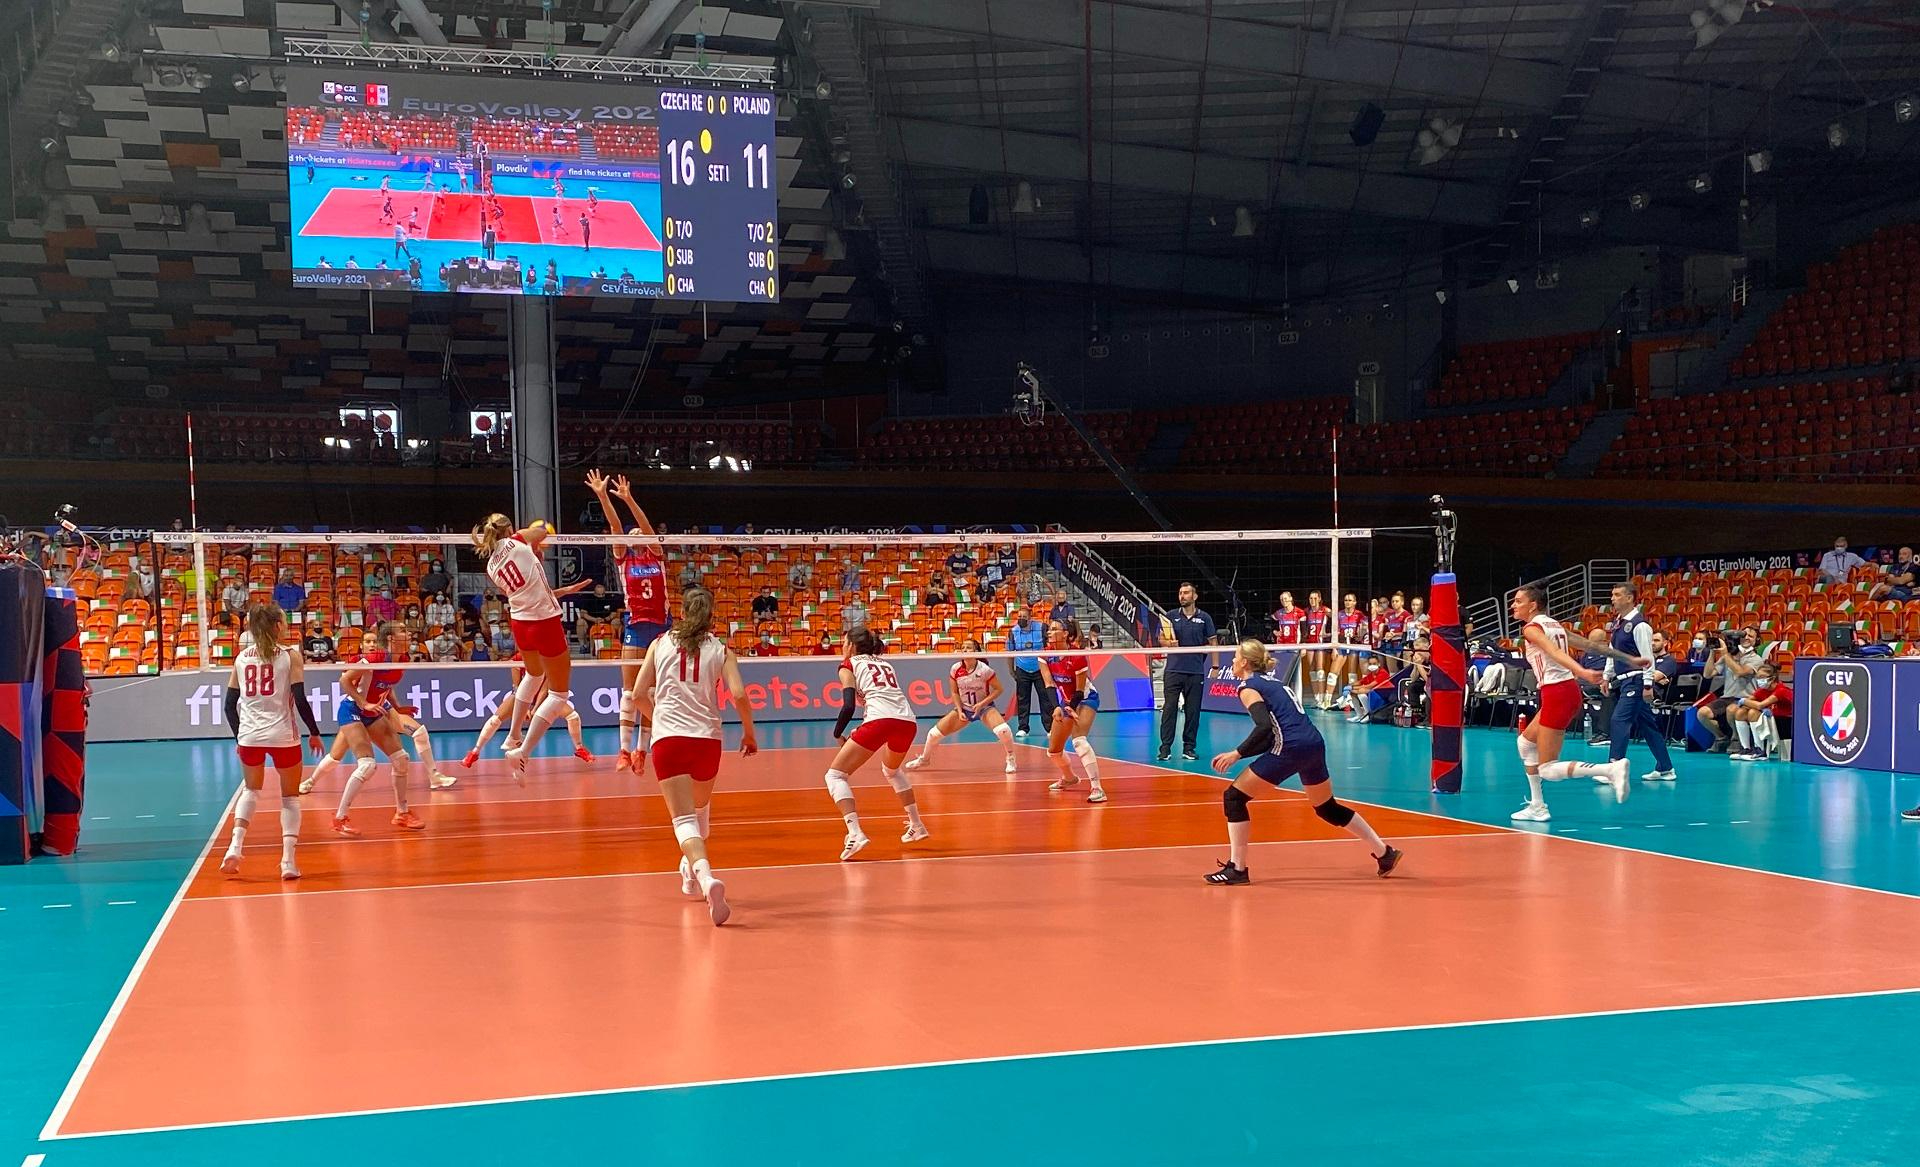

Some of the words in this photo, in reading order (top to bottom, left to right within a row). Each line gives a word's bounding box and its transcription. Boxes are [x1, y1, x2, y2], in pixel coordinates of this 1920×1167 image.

[402, 97, 582, 120] EuroVolley
[592, 105, 659, 120] 202
[660, 91, 690, 110] CZECH
[691, 93, 703, 111] RE
[707, 95, 714, 114] 0
[719, 96, 727, 115] 0
[733, 96, 770, 115] POLAND
[496, 163, 529, 174] Plovdiv
[568, 168, 583, 176] find
[584, 169, 595, 177] the
[597, 169, 621, 178] tickets
[667, 139, 695, 186] 16
[708, 164, 724, 182] SET
[743, 143, 768, 189] 11
[665, 216, 674, 239] 0
[675, 220, 693, 240] T/O
[747, 223, 764, 243] T/O
[766, 221, 774, 243] 2
[666, 245, 675, 267] 0
[676, 249, 693, 265] SUB
[748, 251, 765, 268] SUB
[766, 249, 774, 271] 0
[293, 273, 342, 285] EuroVolley
[345, 274, 367, 284] 2021
[601, 284, 620, 294] CEV
[667, 273, 675, 296] 0
[677, 277, 694, 293] CHA
[749, 280, 766, 295] CHA
[767, 276, 775, 299] 0
[1362, 363, 1377, 373] WC
[1699, 559, 1718, 572] CEV
[1719, 557, 1767, 574] EuroVolley
[1769, 555, 1791, 569] 2021
[498, 560, 526, 593] 10
[641, 578, 653, 600] 3
[1066, 551, 1083, 576] CEV
[1082, 564, 1119, 612] EuroVolley
[1117, 595, 1137, 625] 2021
[1283, 625, 1291, 637] 8
[1309, 624, 1317, 636] 2
[1555, 633, 1568, 655] 17
[676, 645, 701, 683] 11
[244, 663, 276, 698] 88
[867, 663, 898, 689] 26
[1826, 670, 1854, 686] CEV
[965, 691, 978, 706] 11
[1819, 734, 1847, 756] EuroVolley
[1846, 736, 1860, 752] 2021
